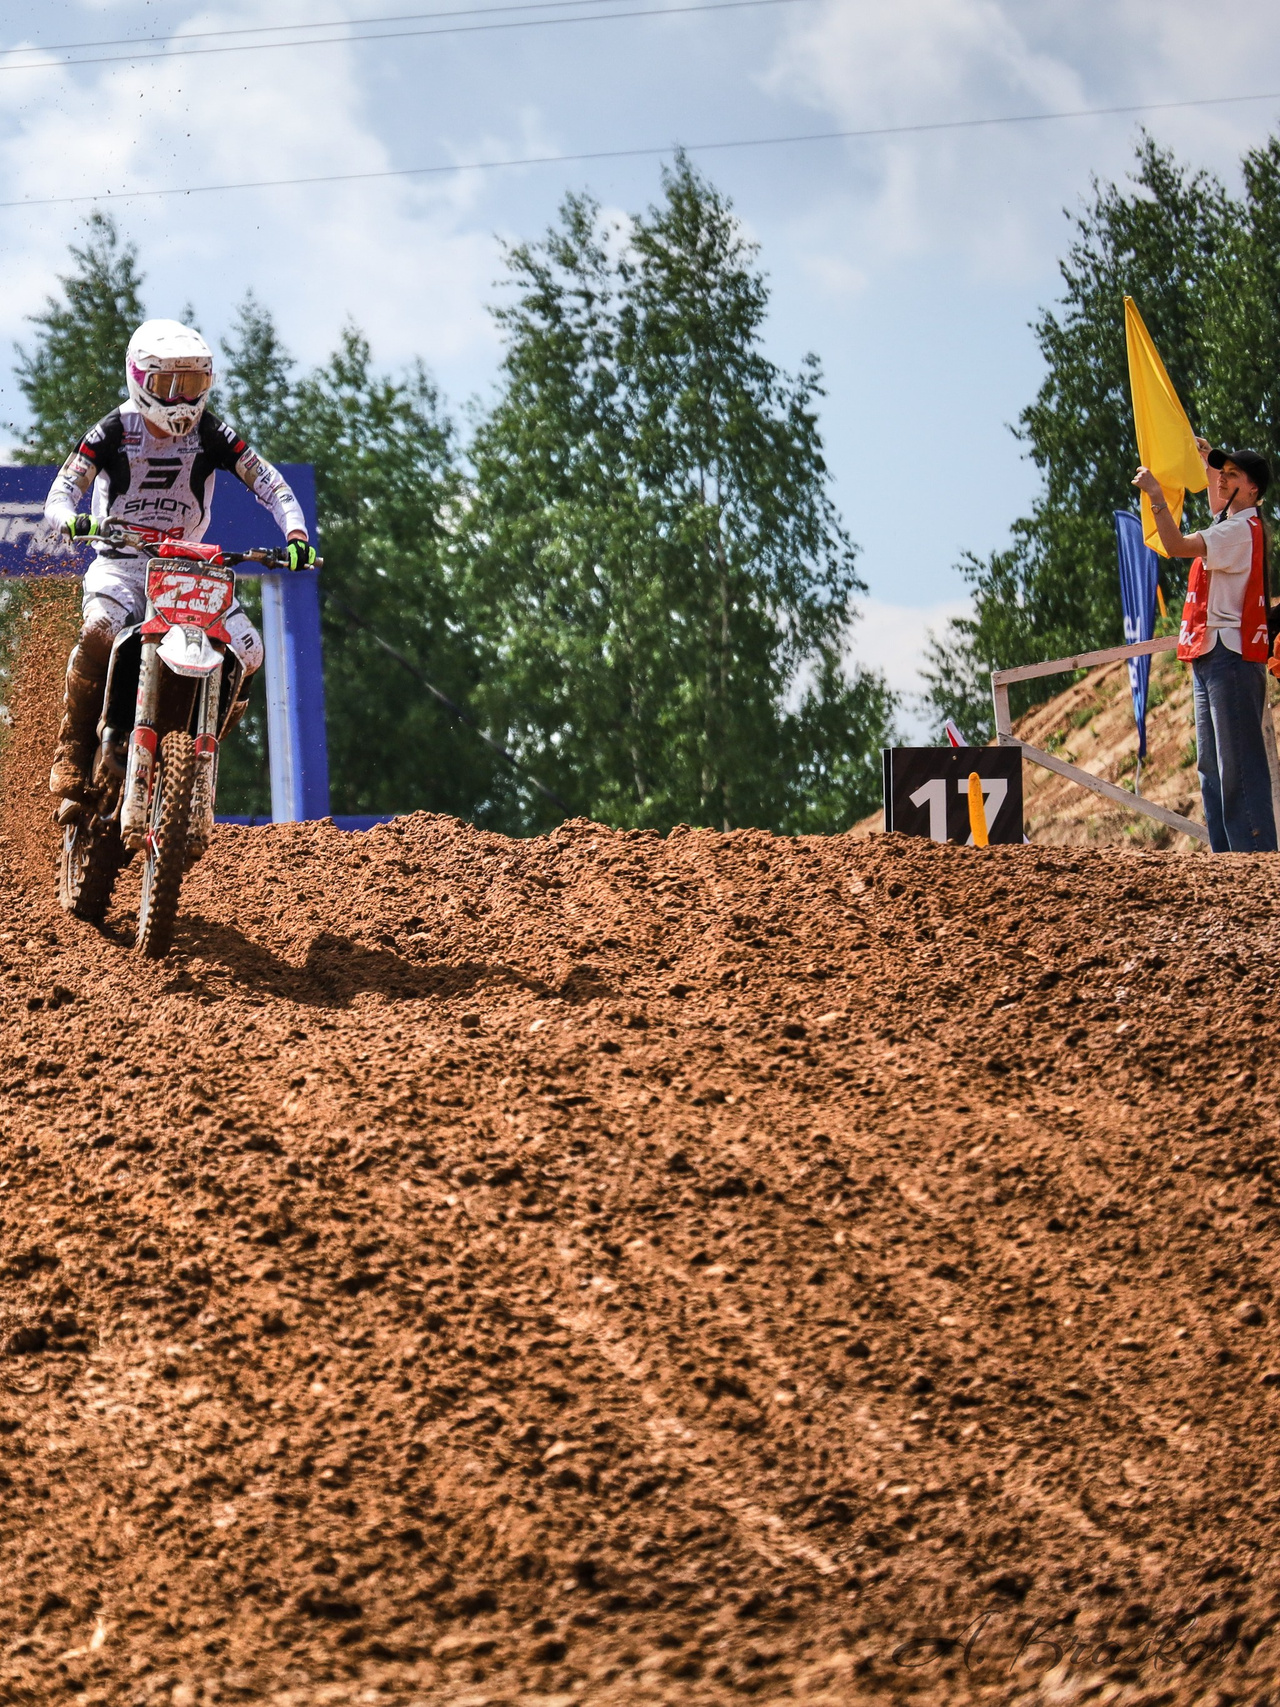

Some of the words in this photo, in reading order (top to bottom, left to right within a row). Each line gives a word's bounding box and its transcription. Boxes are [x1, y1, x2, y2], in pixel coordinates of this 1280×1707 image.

[123, 497, 191, 515] SHOT
[154, 575, 228, 614] 23
[909, 779, 1008, 846] 17
